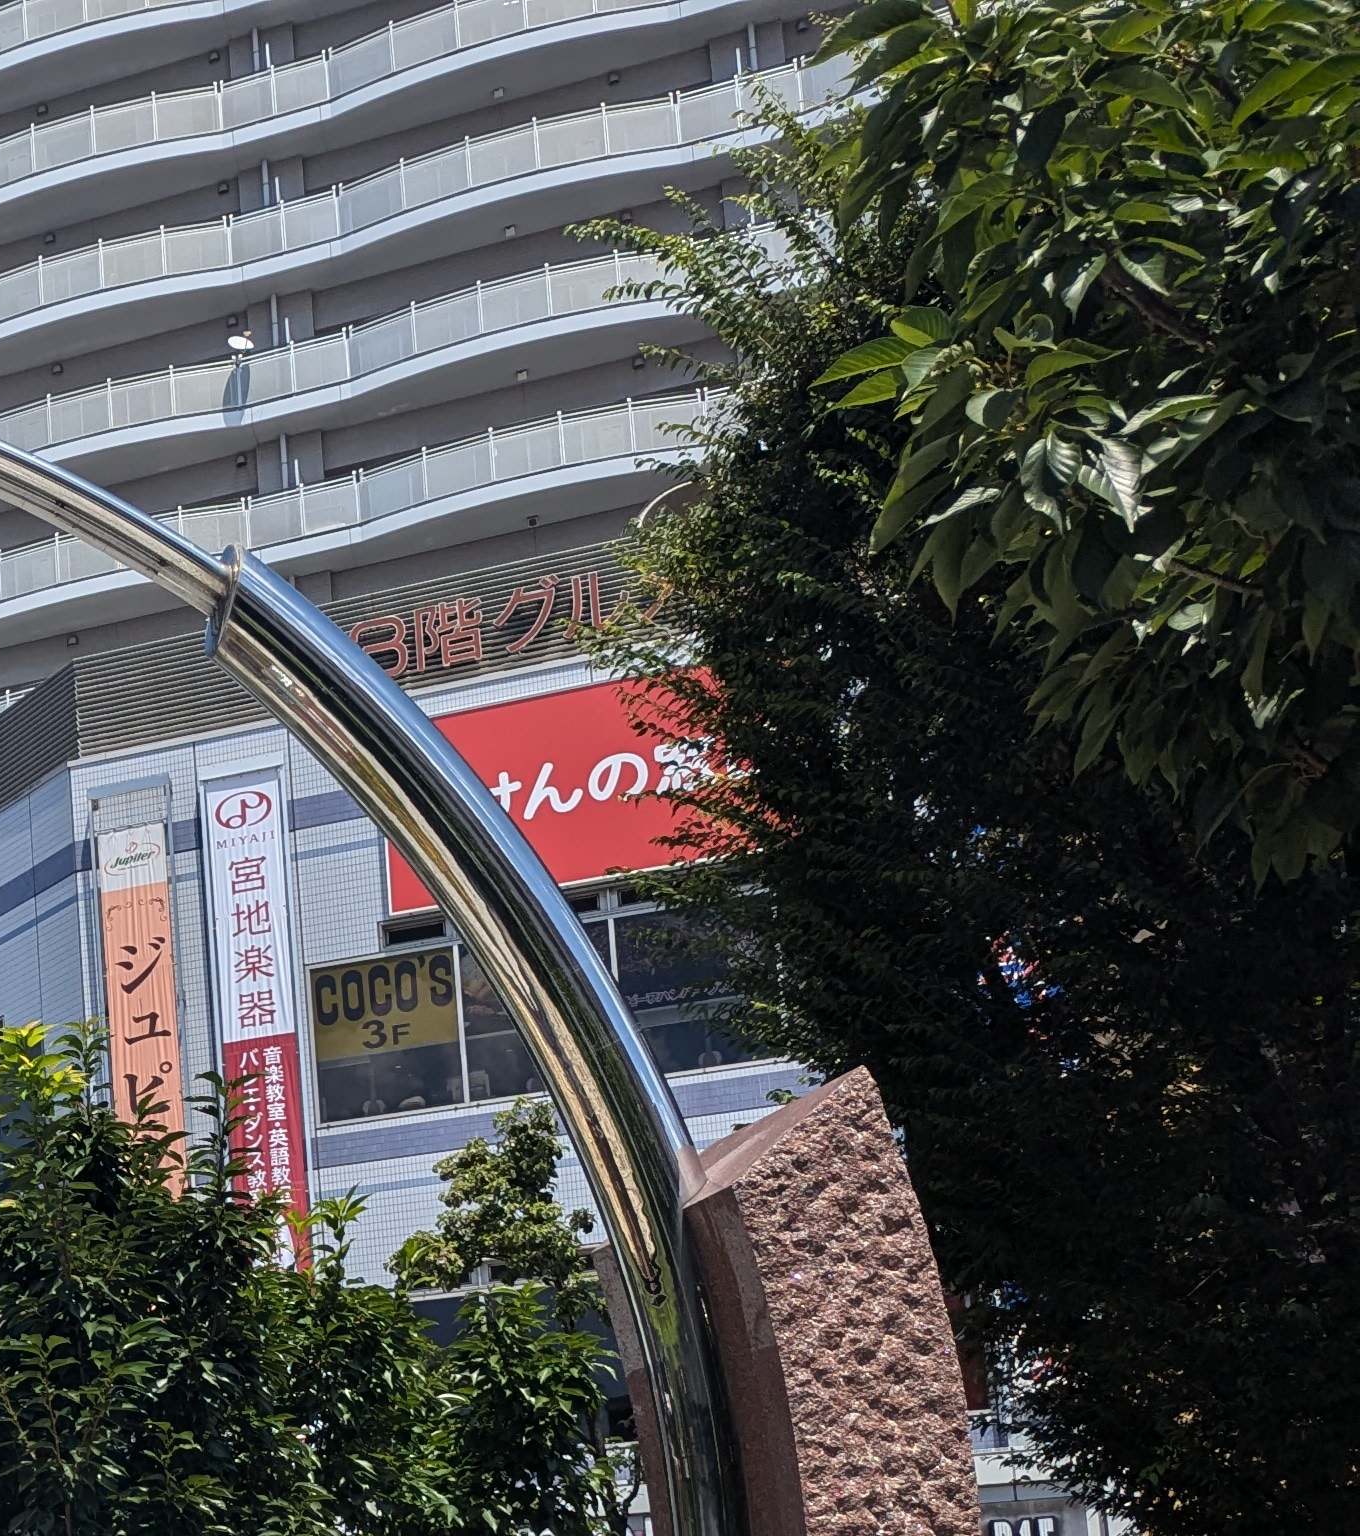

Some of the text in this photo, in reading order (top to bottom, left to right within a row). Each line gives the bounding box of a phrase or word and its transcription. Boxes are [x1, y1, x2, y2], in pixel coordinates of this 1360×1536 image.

[216, 829, 275, 850] MIYAJI
[110, 850, 156, 869] Jupiter
[228, 855, 277, 1030] 宮地楽器
[314, 953, 453, 1026] COCO'S
[361, 1019, 411, 1050] 3F
